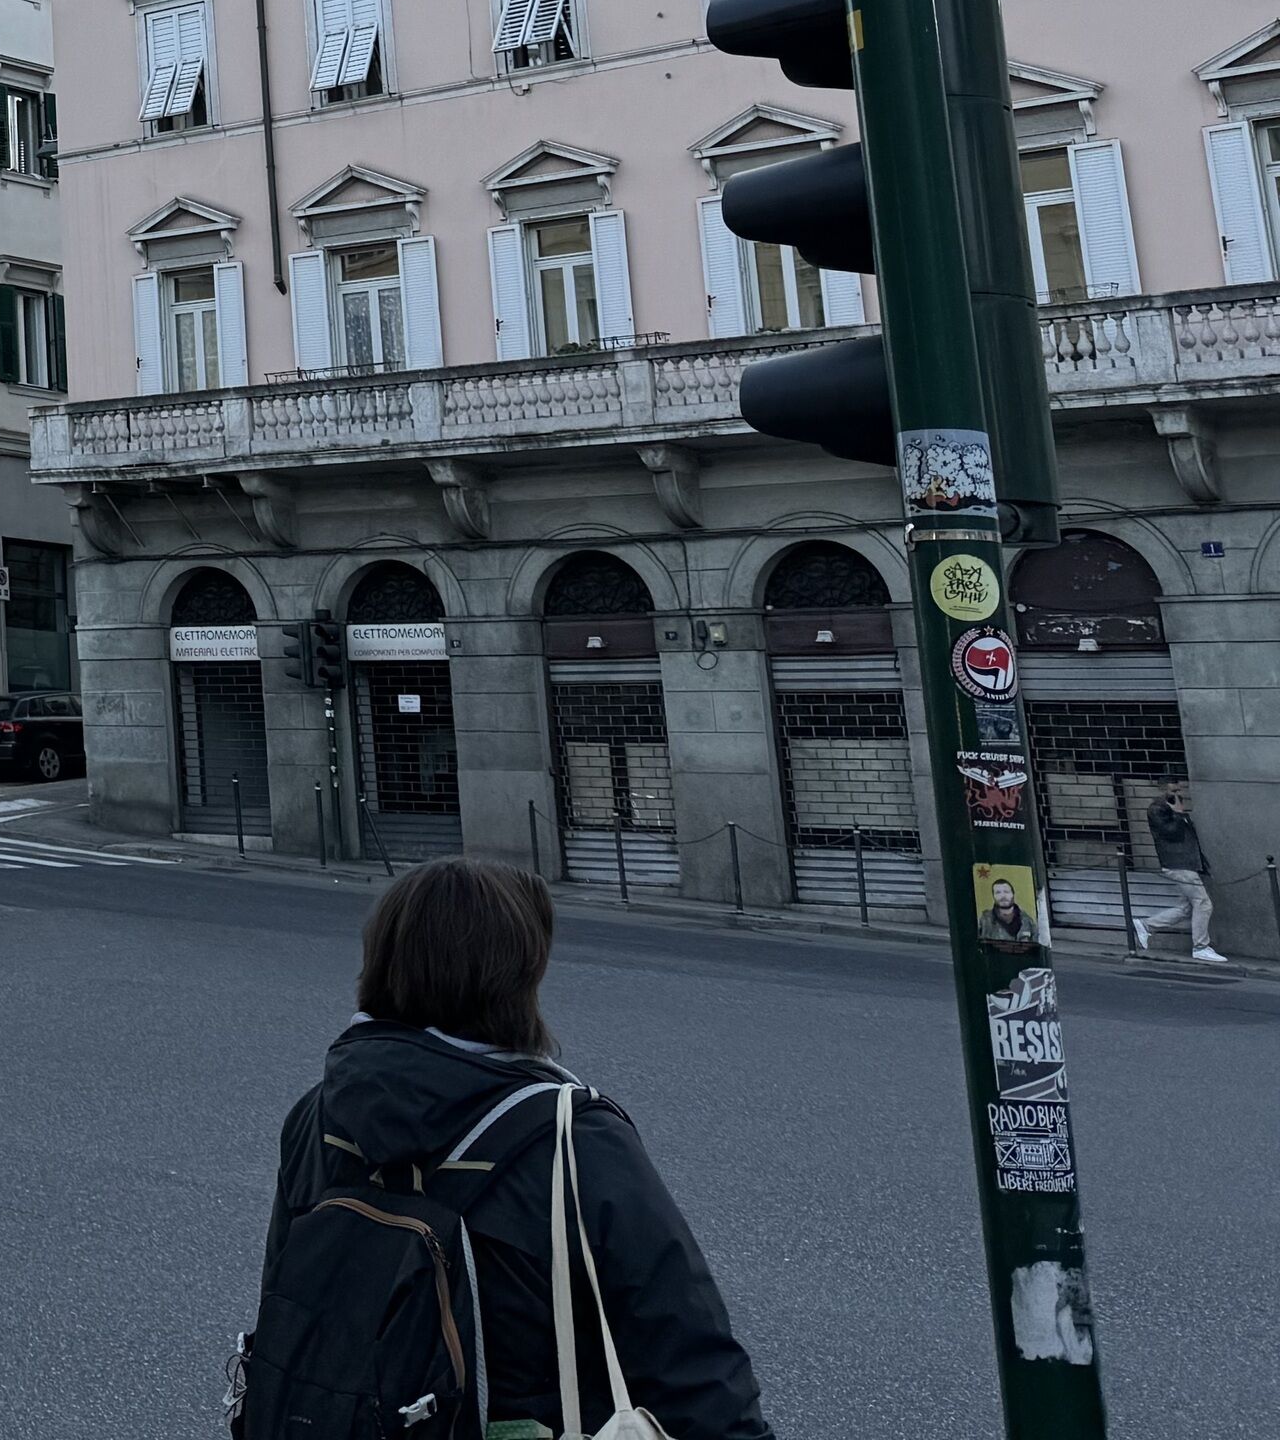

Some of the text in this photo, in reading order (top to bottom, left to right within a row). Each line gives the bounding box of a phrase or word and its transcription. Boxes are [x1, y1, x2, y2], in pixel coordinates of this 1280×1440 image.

[1210, 543, 1215, 554] 1
[175, 629, 257, 641] ELETTROMEMORY
[353, 627, 445, 639] ELETTROMEMORY
[175, 646, 257, 657] MATERIALI ELETTRIC
[957, 751, 978, 760] FUCK
[980, 753, 1008, 762] CRUISE
[991, 1019, 1064, 1064] RESIS
